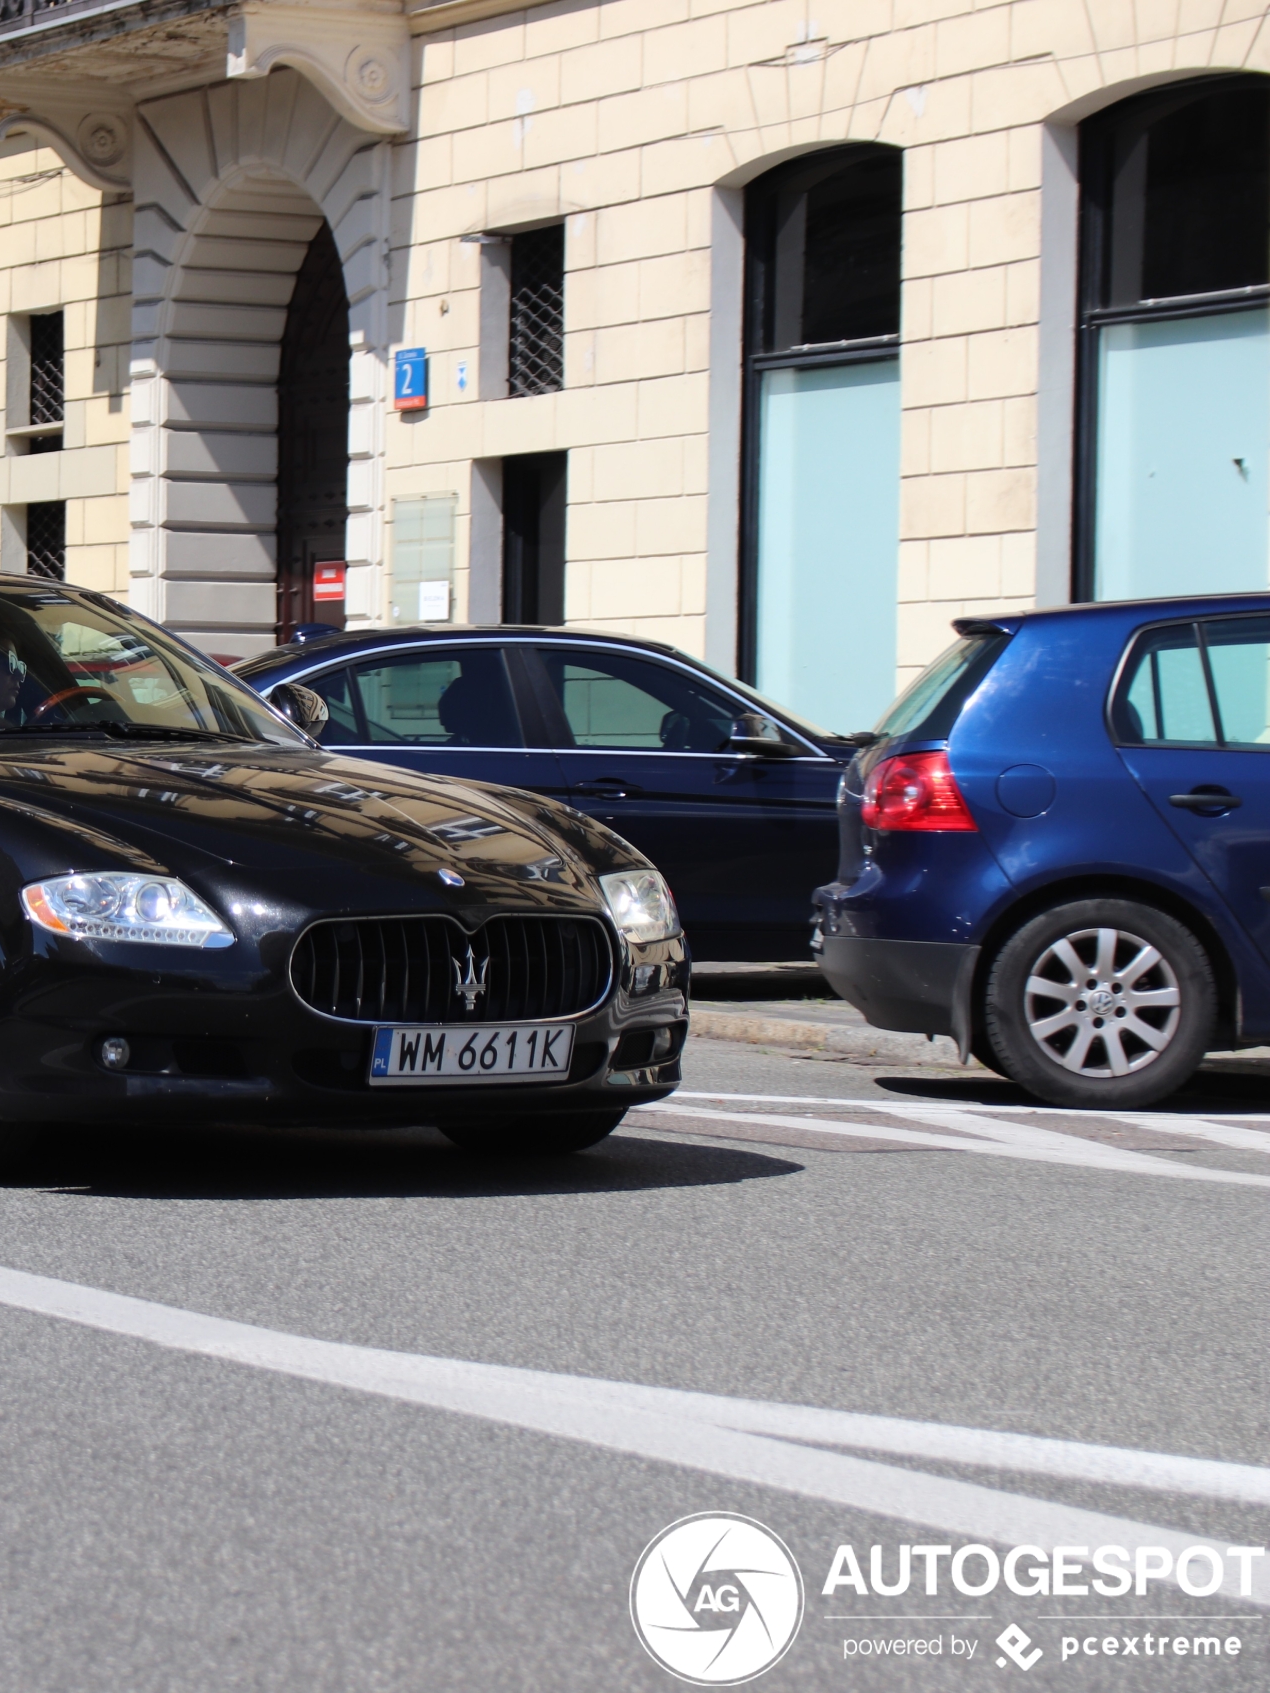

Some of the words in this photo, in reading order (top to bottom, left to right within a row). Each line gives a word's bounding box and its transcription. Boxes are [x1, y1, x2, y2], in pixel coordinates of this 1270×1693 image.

[401, 363, 413, 395] 2
[373, 1057, 387, 1069] PL
[398, 1033, 446, 1072] WM
[458, 1029, 564, 1071] 6611K
